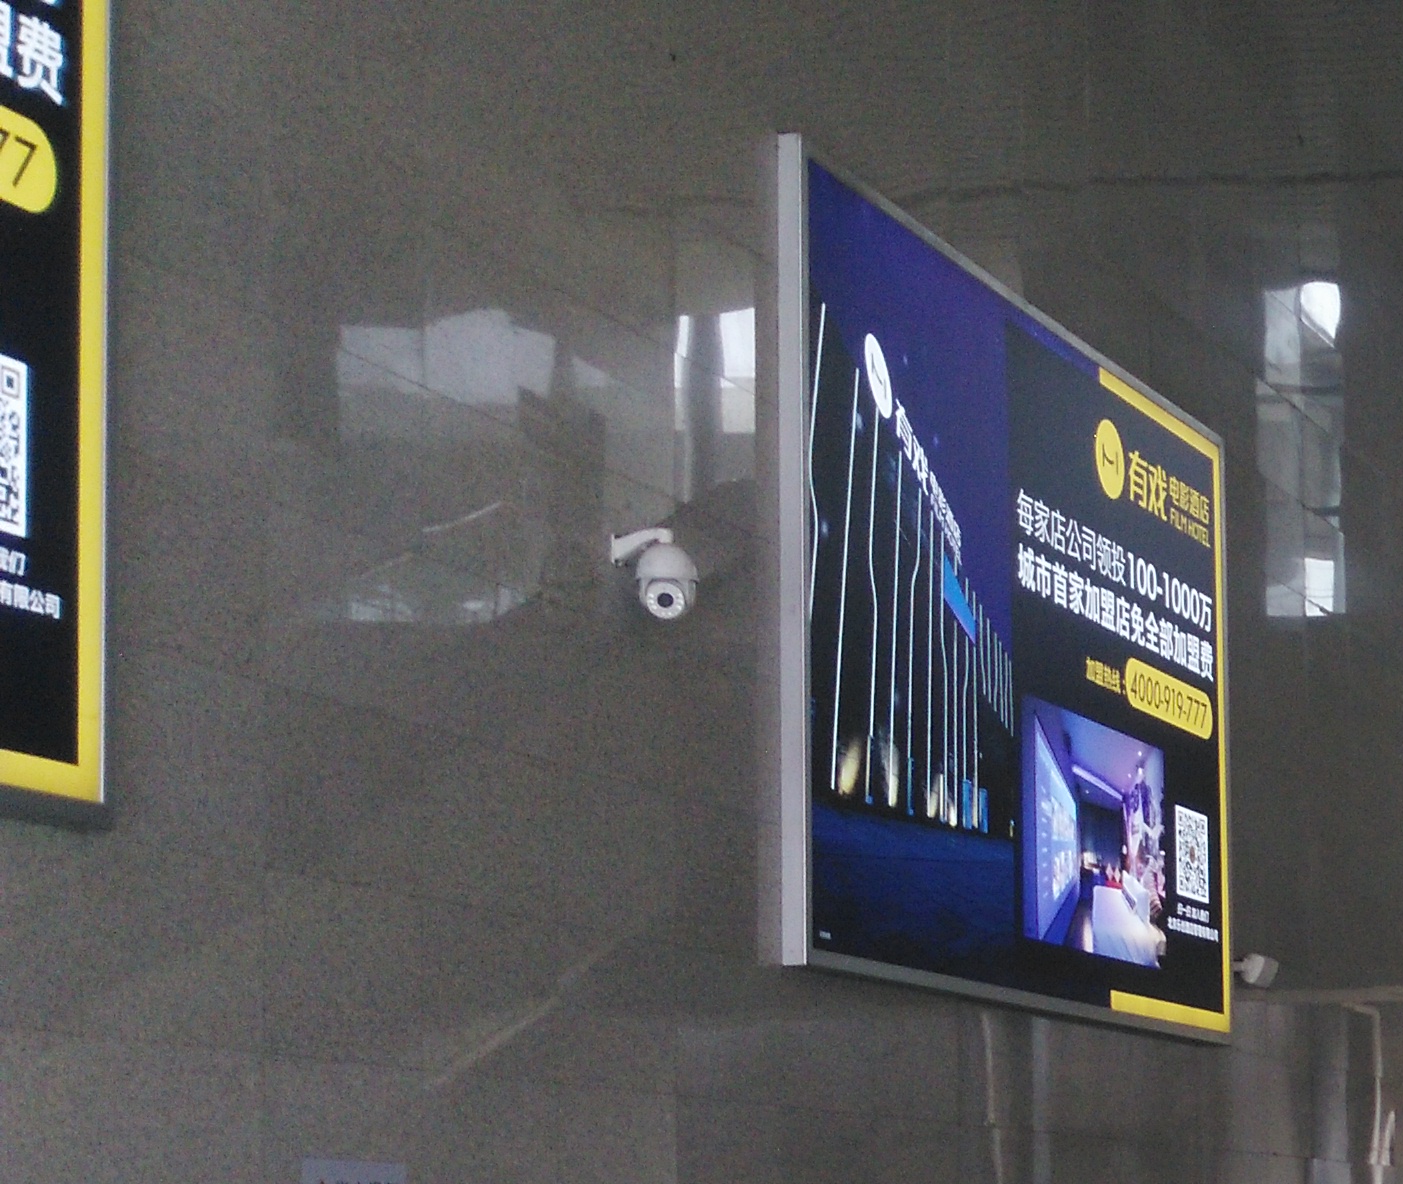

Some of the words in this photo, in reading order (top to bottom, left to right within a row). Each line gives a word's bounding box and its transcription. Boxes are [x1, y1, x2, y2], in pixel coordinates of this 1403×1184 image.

[1128, 450, 1168, 522] 有戏
[1168, 476, 1211, 526] 电影酒店
[1188, 522, 1212, 549] HOTEL
[1017, 542, 1214, 683] 城市首家加盟店免全部加盟费
[1130, 671, 1209, 730] 4000-919-777
